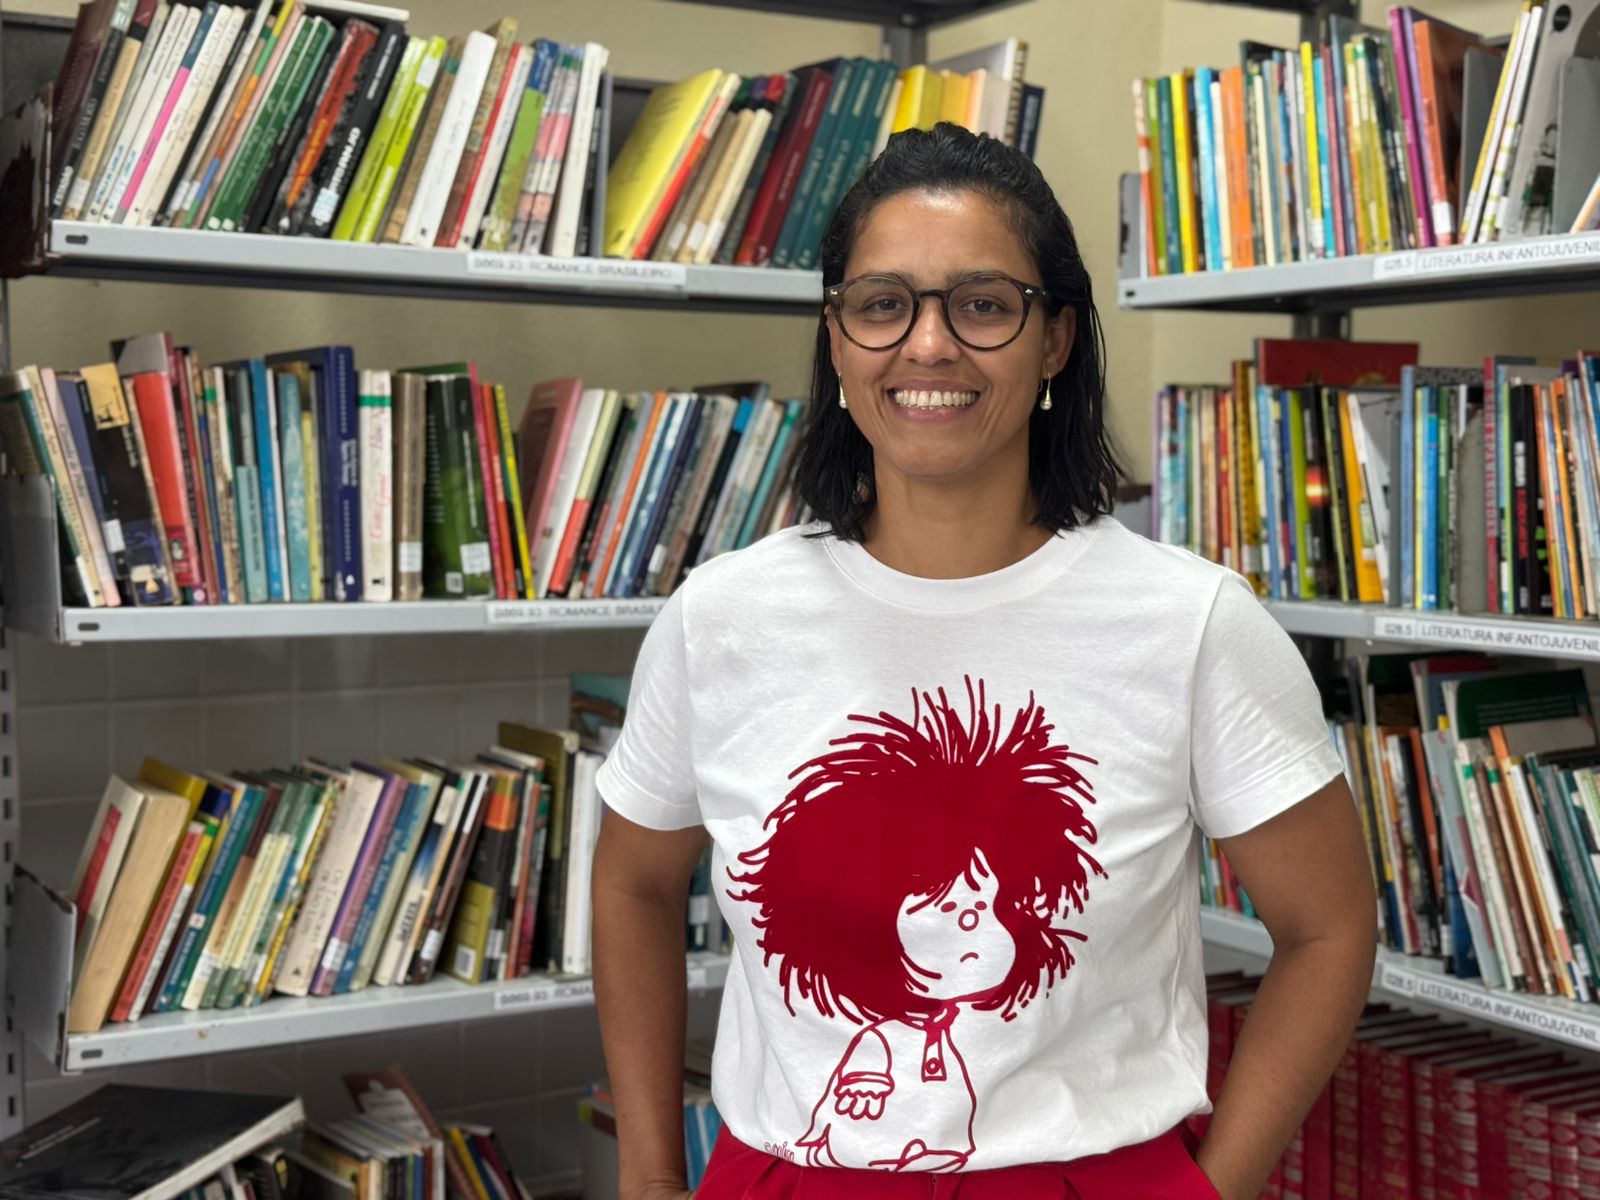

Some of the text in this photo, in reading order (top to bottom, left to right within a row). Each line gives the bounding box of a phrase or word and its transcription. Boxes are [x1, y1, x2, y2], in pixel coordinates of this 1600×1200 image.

[1422, 251, 1494, 269] LITERATURA
[1497, 240, 1600, 261] INFANTOJUVENIL
[530, 261, 594, 275] ROMANCE
[600, 264, 672, 279] BRASILEIRO
[550, 605, 610, 618] ROMANCE
[615, 603, 664, 617] BRASILE
[1421, 624, 1494, 641] LITERATURA
[1497, 630, 1600, 651] INFANTOJUVENIL
[1420, 981, 1493, 1011] LITERATURA
[1494, 1001, 1599, 1044] INFANTOJUVENIL
